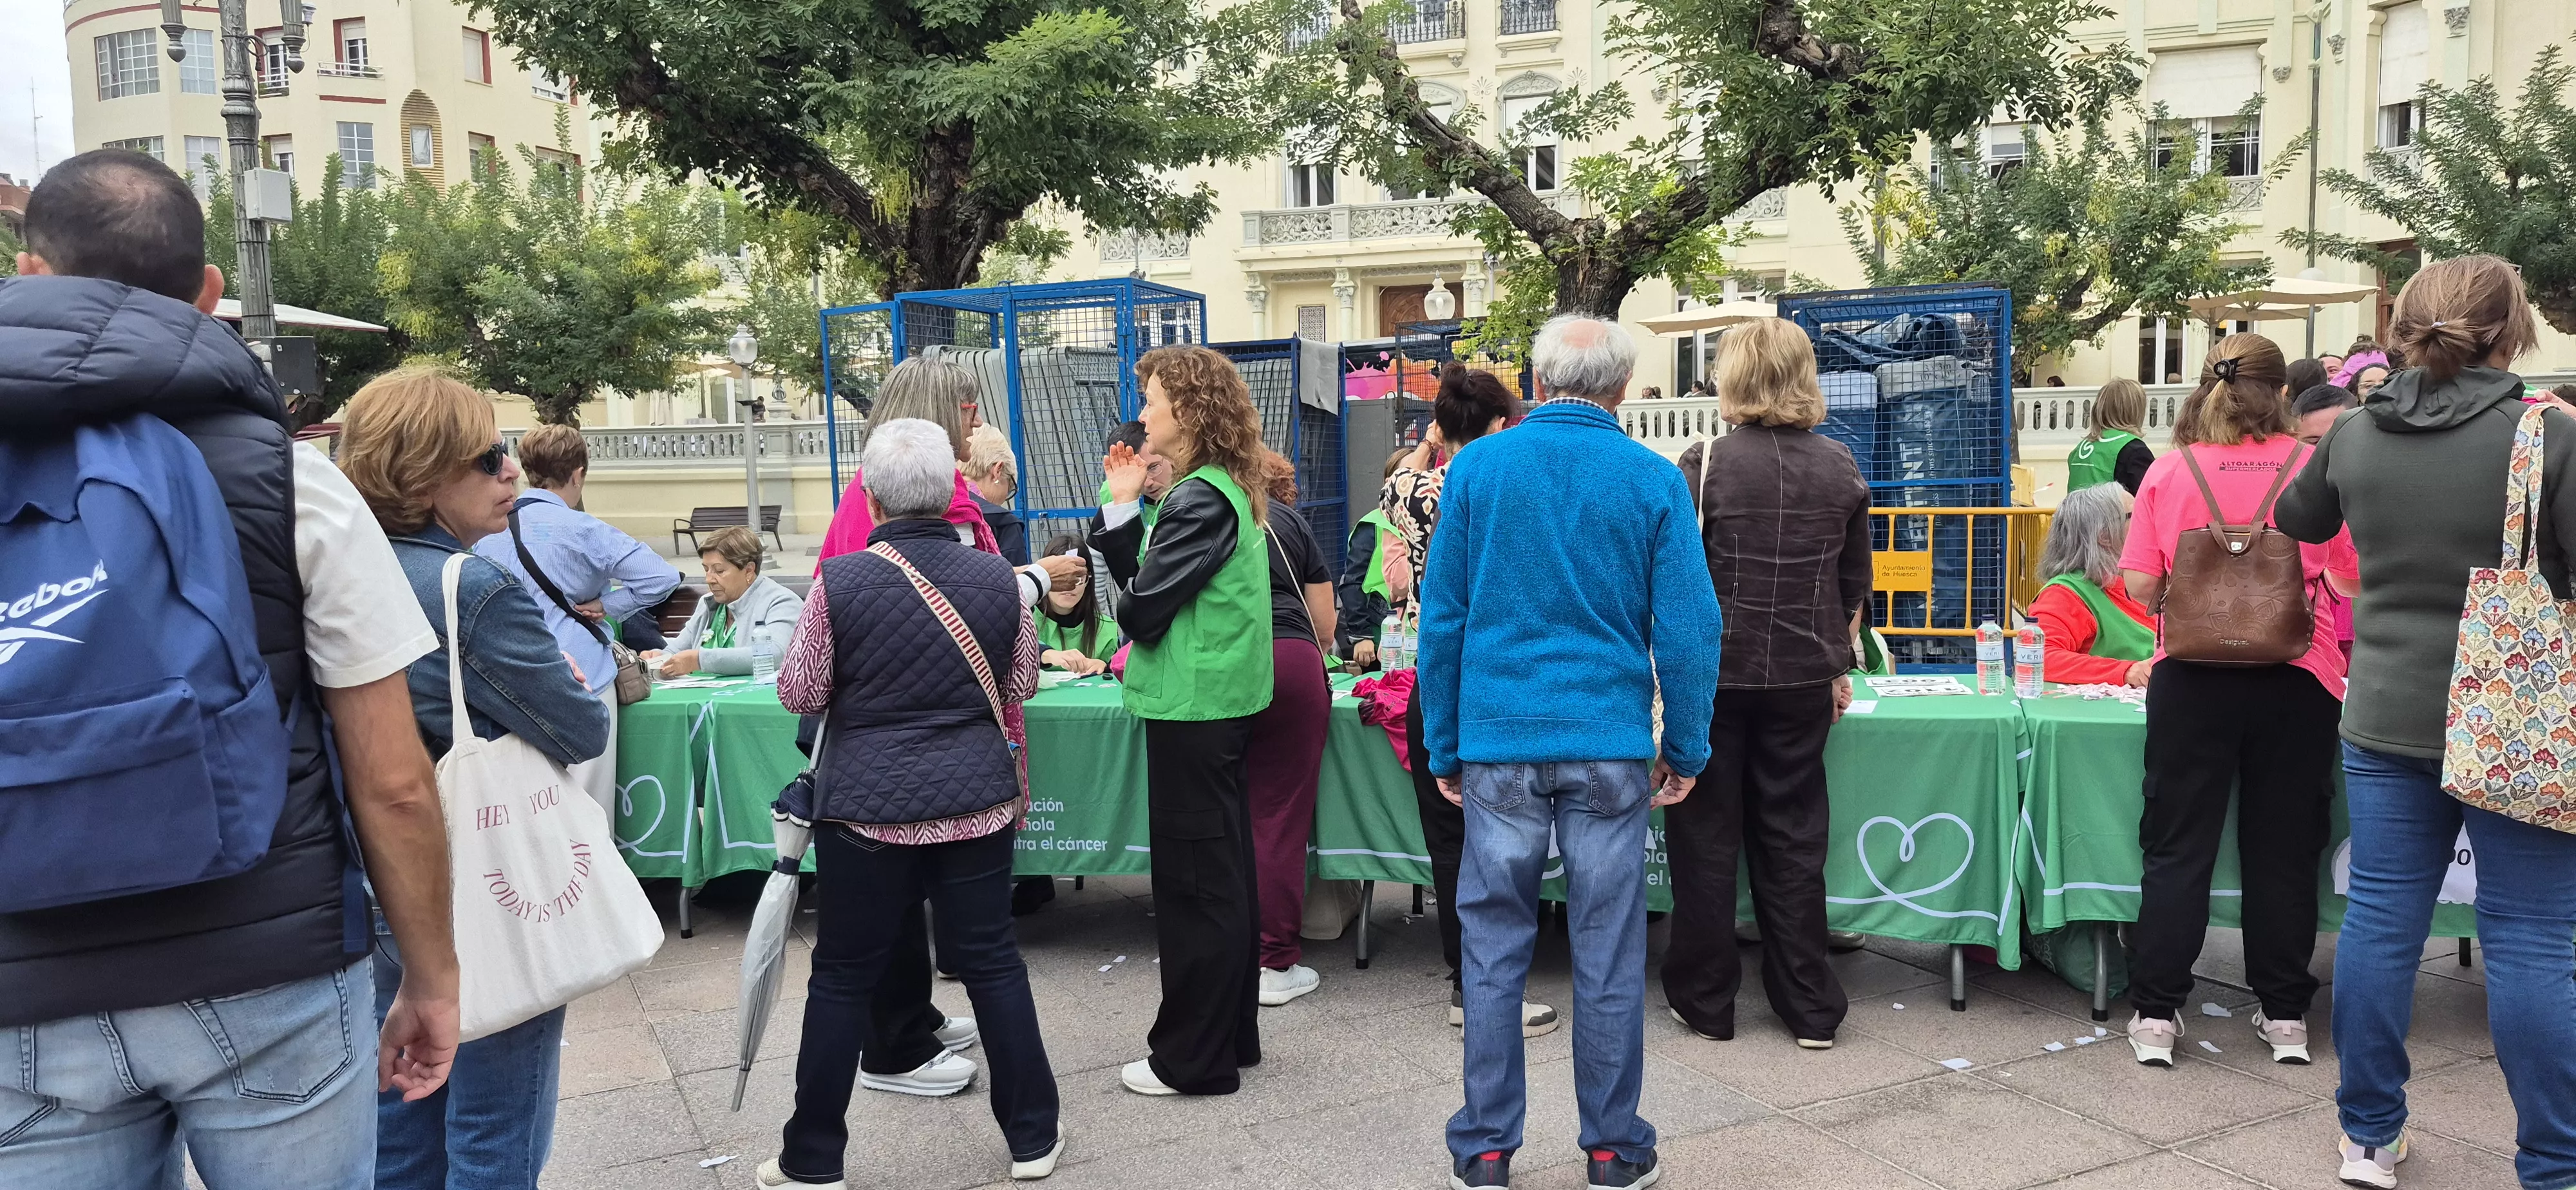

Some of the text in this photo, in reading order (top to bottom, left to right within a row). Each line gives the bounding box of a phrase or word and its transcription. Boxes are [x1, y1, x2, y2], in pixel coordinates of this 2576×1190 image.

[476, 784, 560, 831] HEY YOU
[1041, 836, 1054, 850] el
[1057, 836, 1108, 851] cáncer
[483, 838, 591, 923] TODAY IS THE DAY
[1647, 870, 1663, 885] el
